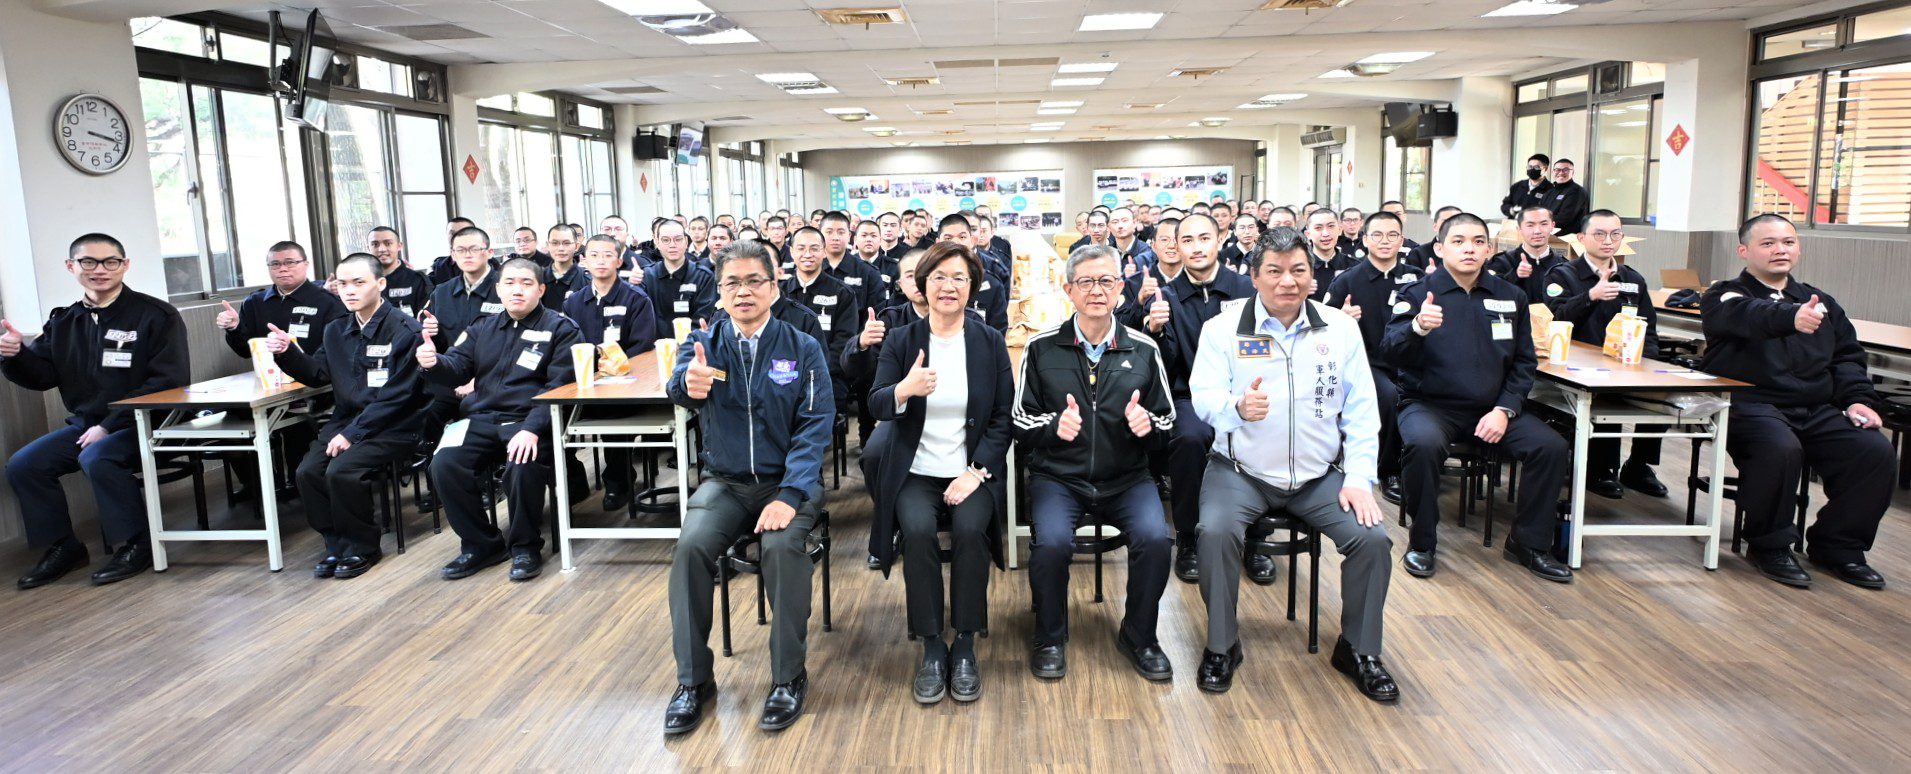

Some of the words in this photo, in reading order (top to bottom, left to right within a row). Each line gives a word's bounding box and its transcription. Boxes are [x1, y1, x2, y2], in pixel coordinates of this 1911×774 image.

[75, 104, 84, 115] 11
[86, 101, 97, 113] 12
[103, 107, 107, 117] 1
[65, 113, 79, 125] 10
[110, 118, 119, 129] 2
[63, 126, 71, 137] 9
[114, 130, 123, 141] 3
[68, 140, 77, 151] 8
[1672, 131, 1684, 150] 吉
[113, 143, 120, 154] 4
[78, 151, 86, 161] 7
[91, 155, 100, 166] 6
[104, 152, 112, 163] 5
[1314, 364, 1325, 419] 軍人服務站
